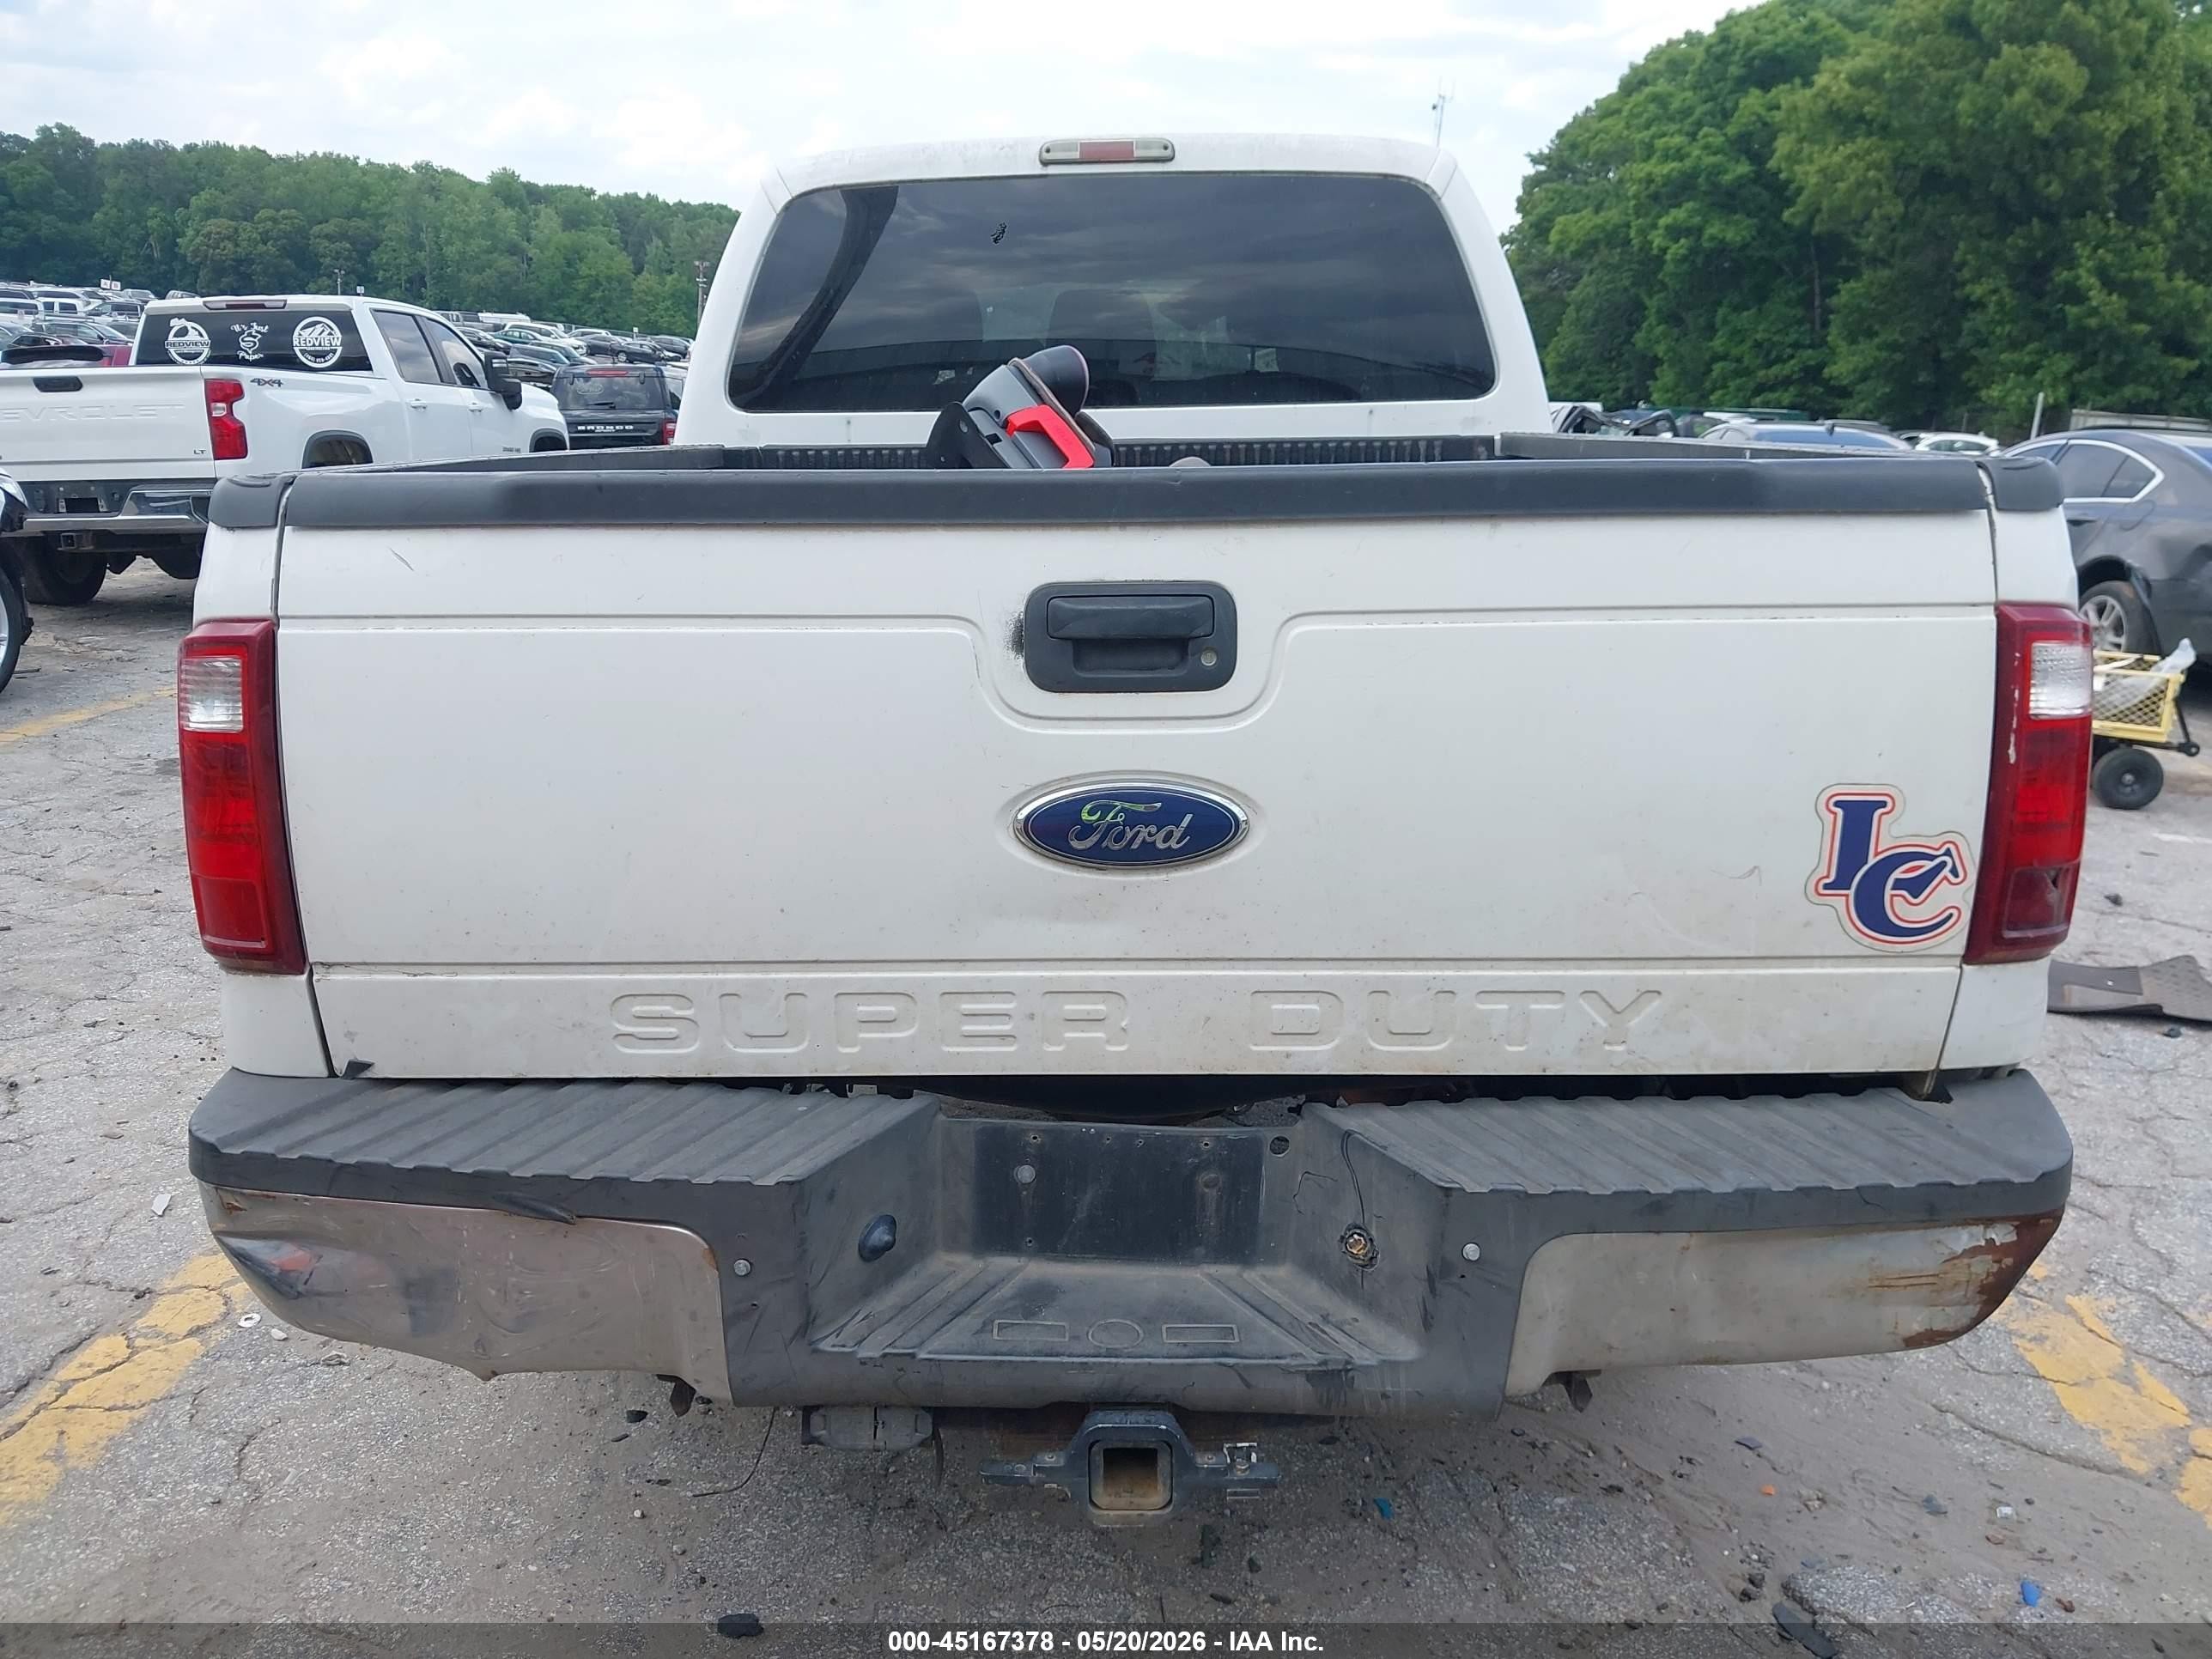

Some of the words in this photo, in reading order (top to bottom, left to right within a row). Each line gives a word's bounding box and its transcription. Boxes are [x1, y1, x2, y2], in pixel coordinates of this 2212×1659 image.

[294, 337, 342, 346] REDVIEW
[1068, 799, 1194, 850] Ford
[609, 988, 1130, 1054] SUPER
[1248, 988, 1664, 1053] DUTY
